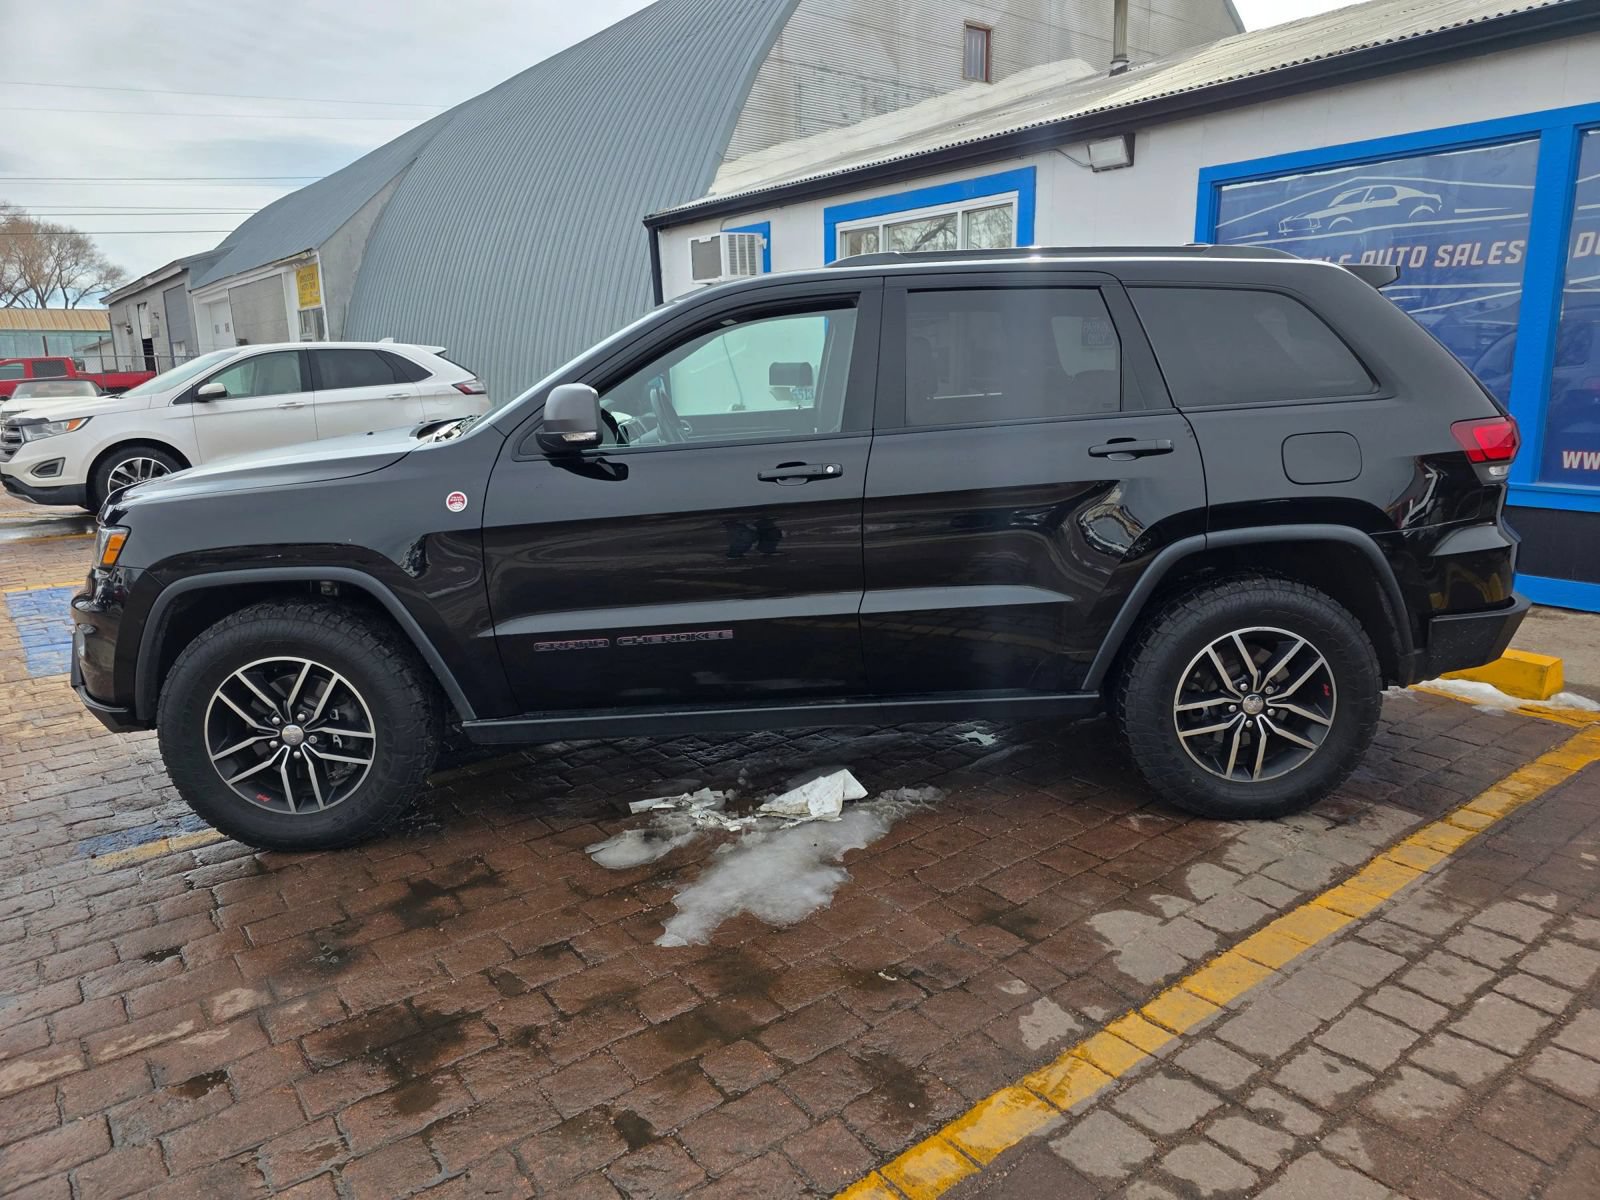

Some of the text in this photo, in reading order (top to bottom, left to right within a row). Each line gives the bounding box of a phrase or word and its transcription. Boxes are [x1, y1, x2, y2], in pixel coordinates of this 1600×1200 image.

[1360, 245, 1428, 269] AUTO
[1434, 239, 1526, 268] SALES
[533, 629, 734, 652] GRAND CHEROKEE
